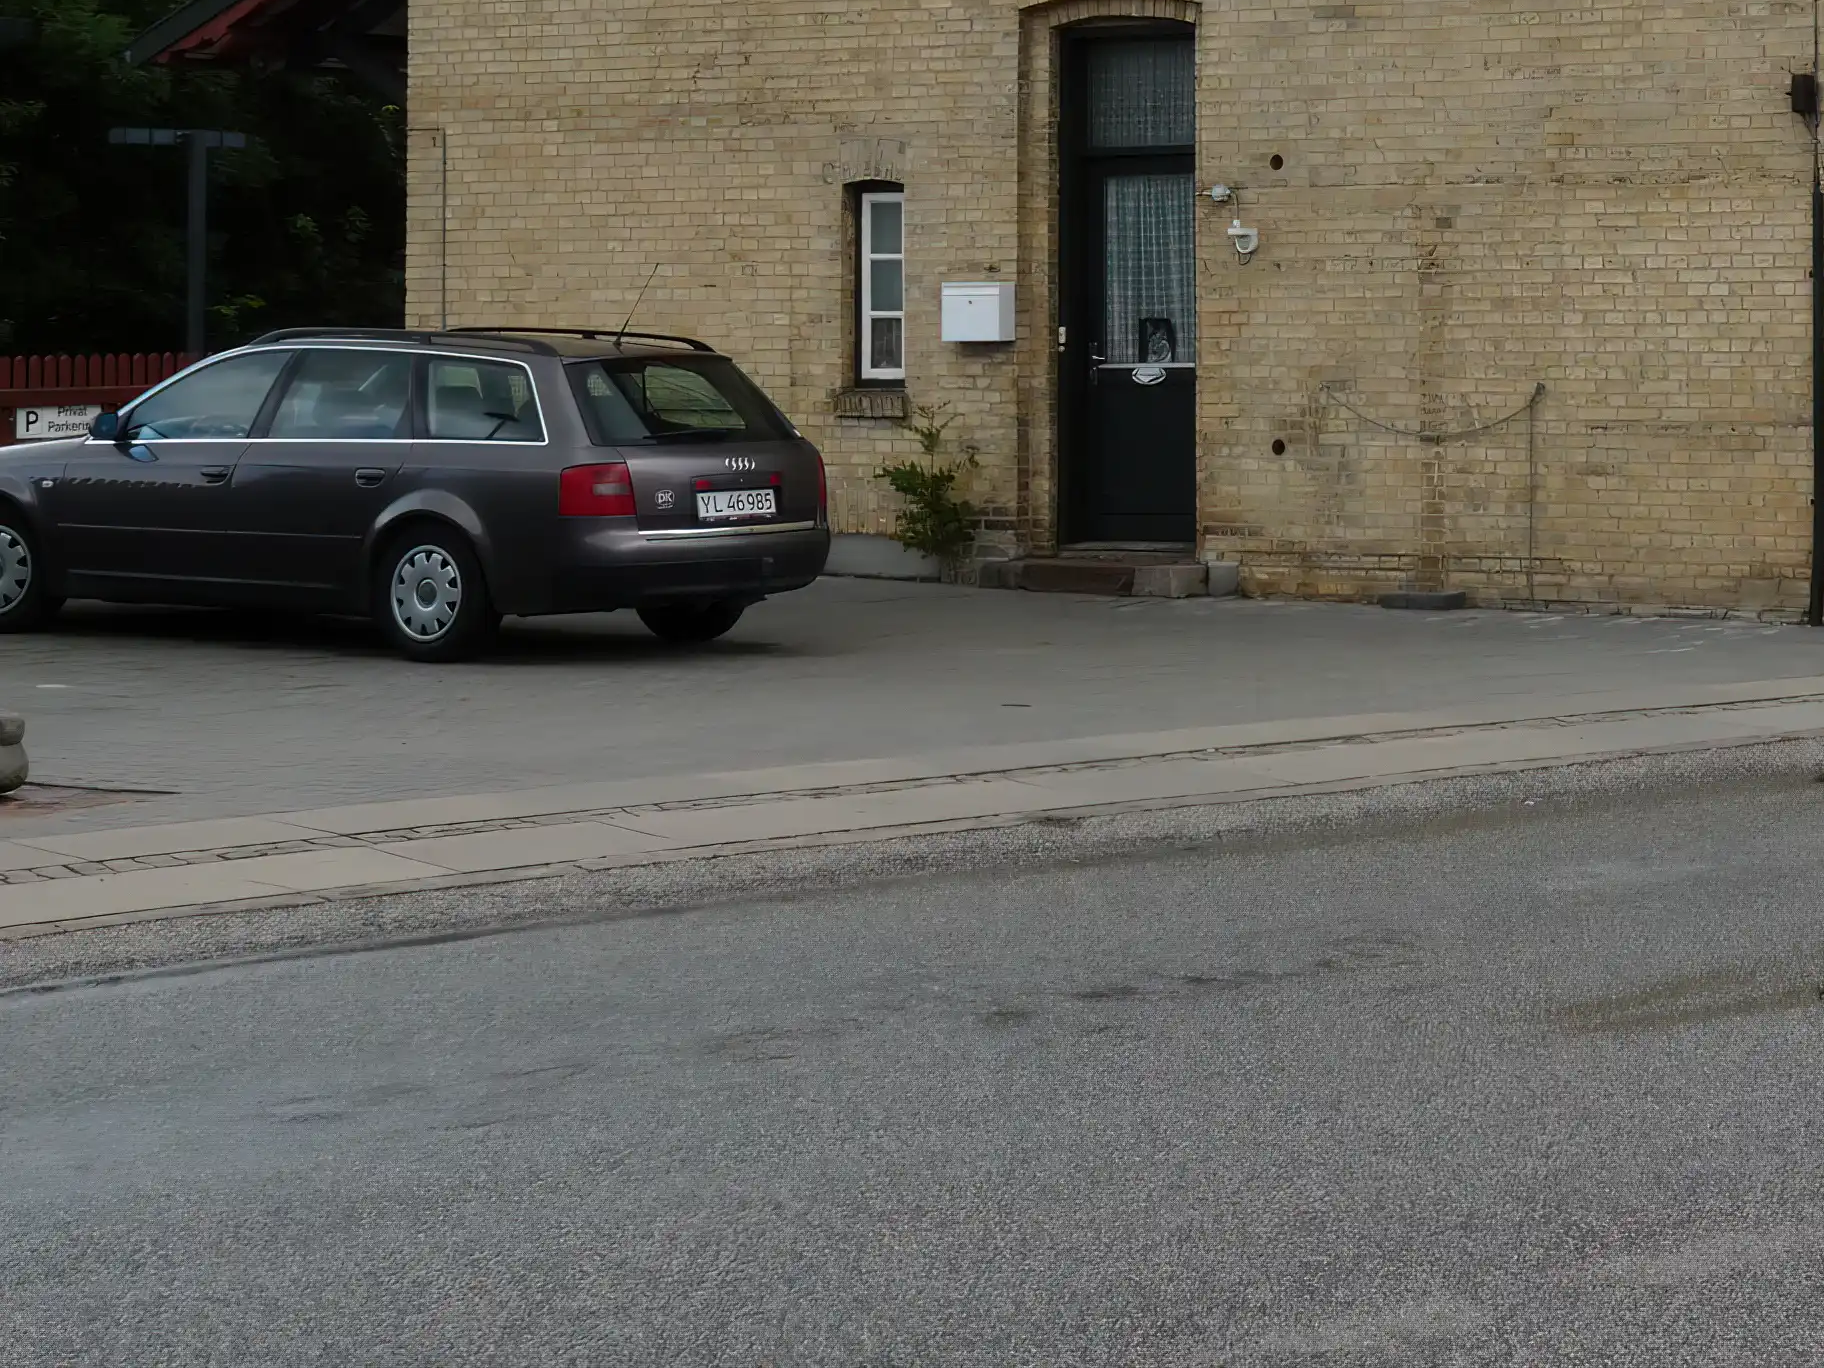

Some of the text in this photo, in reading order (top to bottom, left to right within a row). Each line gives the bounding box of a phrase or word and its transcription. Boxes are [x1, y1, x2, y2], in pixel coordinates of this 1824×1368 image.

[25, 410, 39, 433] P
[47, 420, 91, 433] Parkerin
[700, 495, 724, 513] YL
